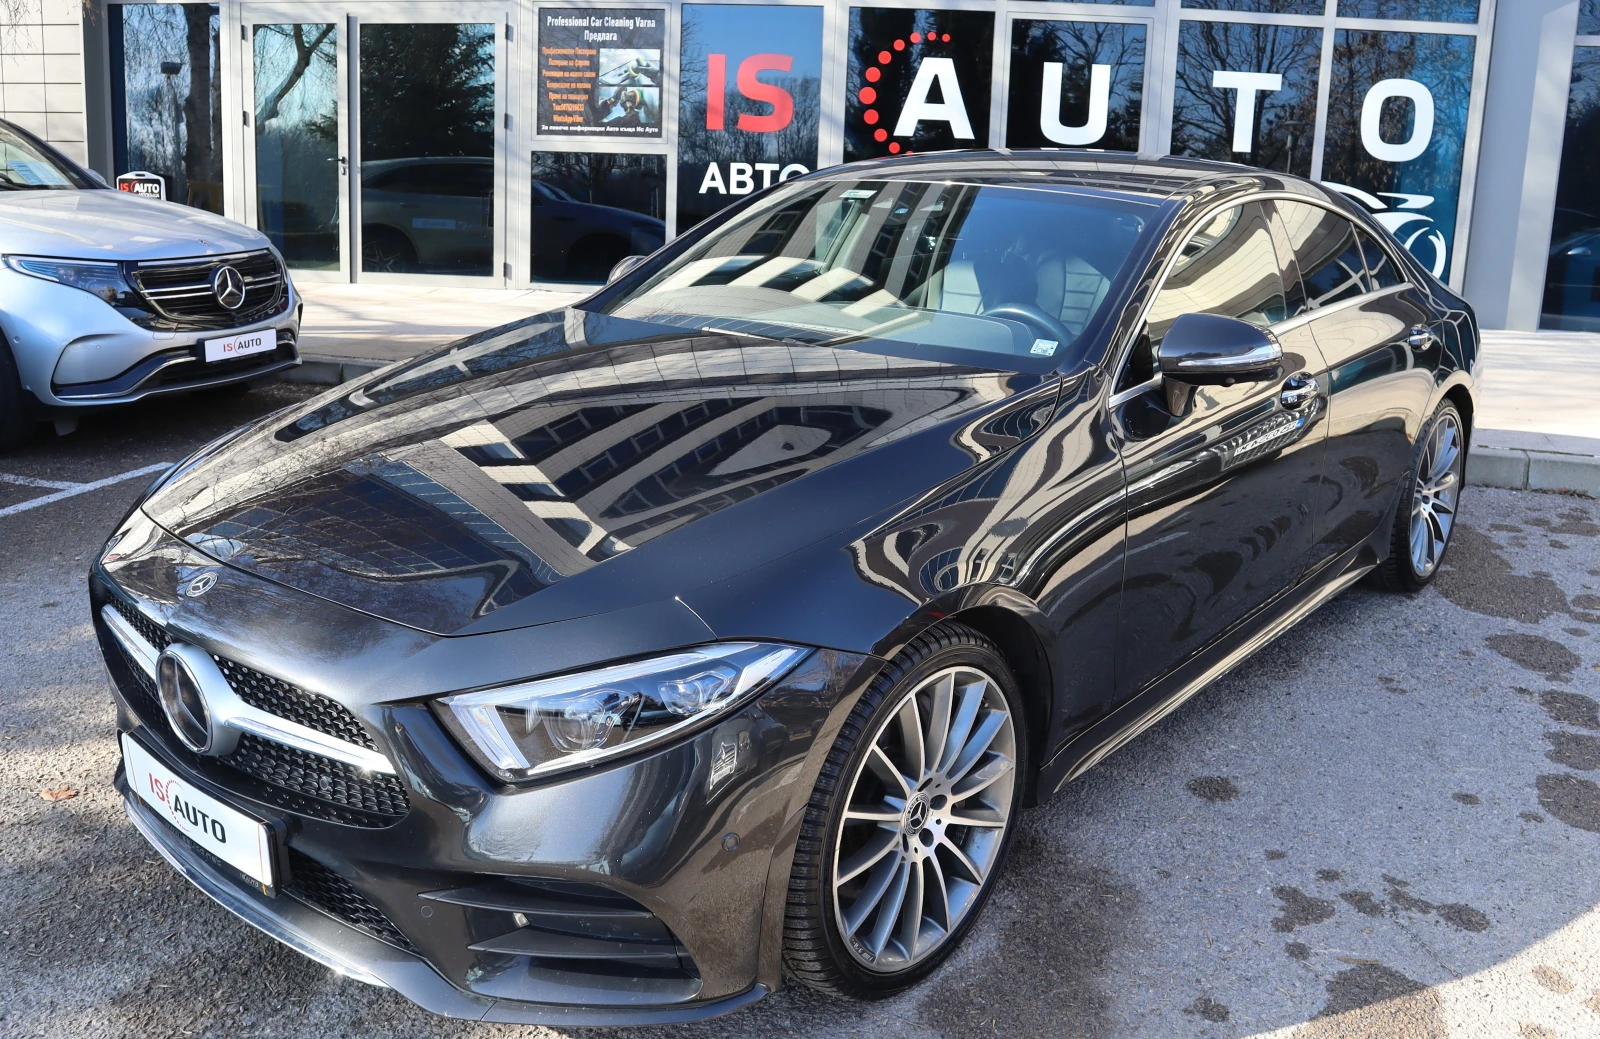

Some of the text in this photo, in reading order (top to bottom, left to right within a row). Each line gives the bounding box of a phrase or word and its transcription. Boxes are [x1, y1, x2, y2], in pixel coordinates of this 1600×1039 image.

[547, 16, 656, 29] Professional Car Cleaning Varna
[584, 30, 618, 42] Предлага
[706, 53, 794, 133] IS
[120, 182, 160, 193] IS AUTO
[223, 337, 262, 353] IS AUTO
[148, 772, 165, 802] IS
[173, 794, 227, 844] AUTO
